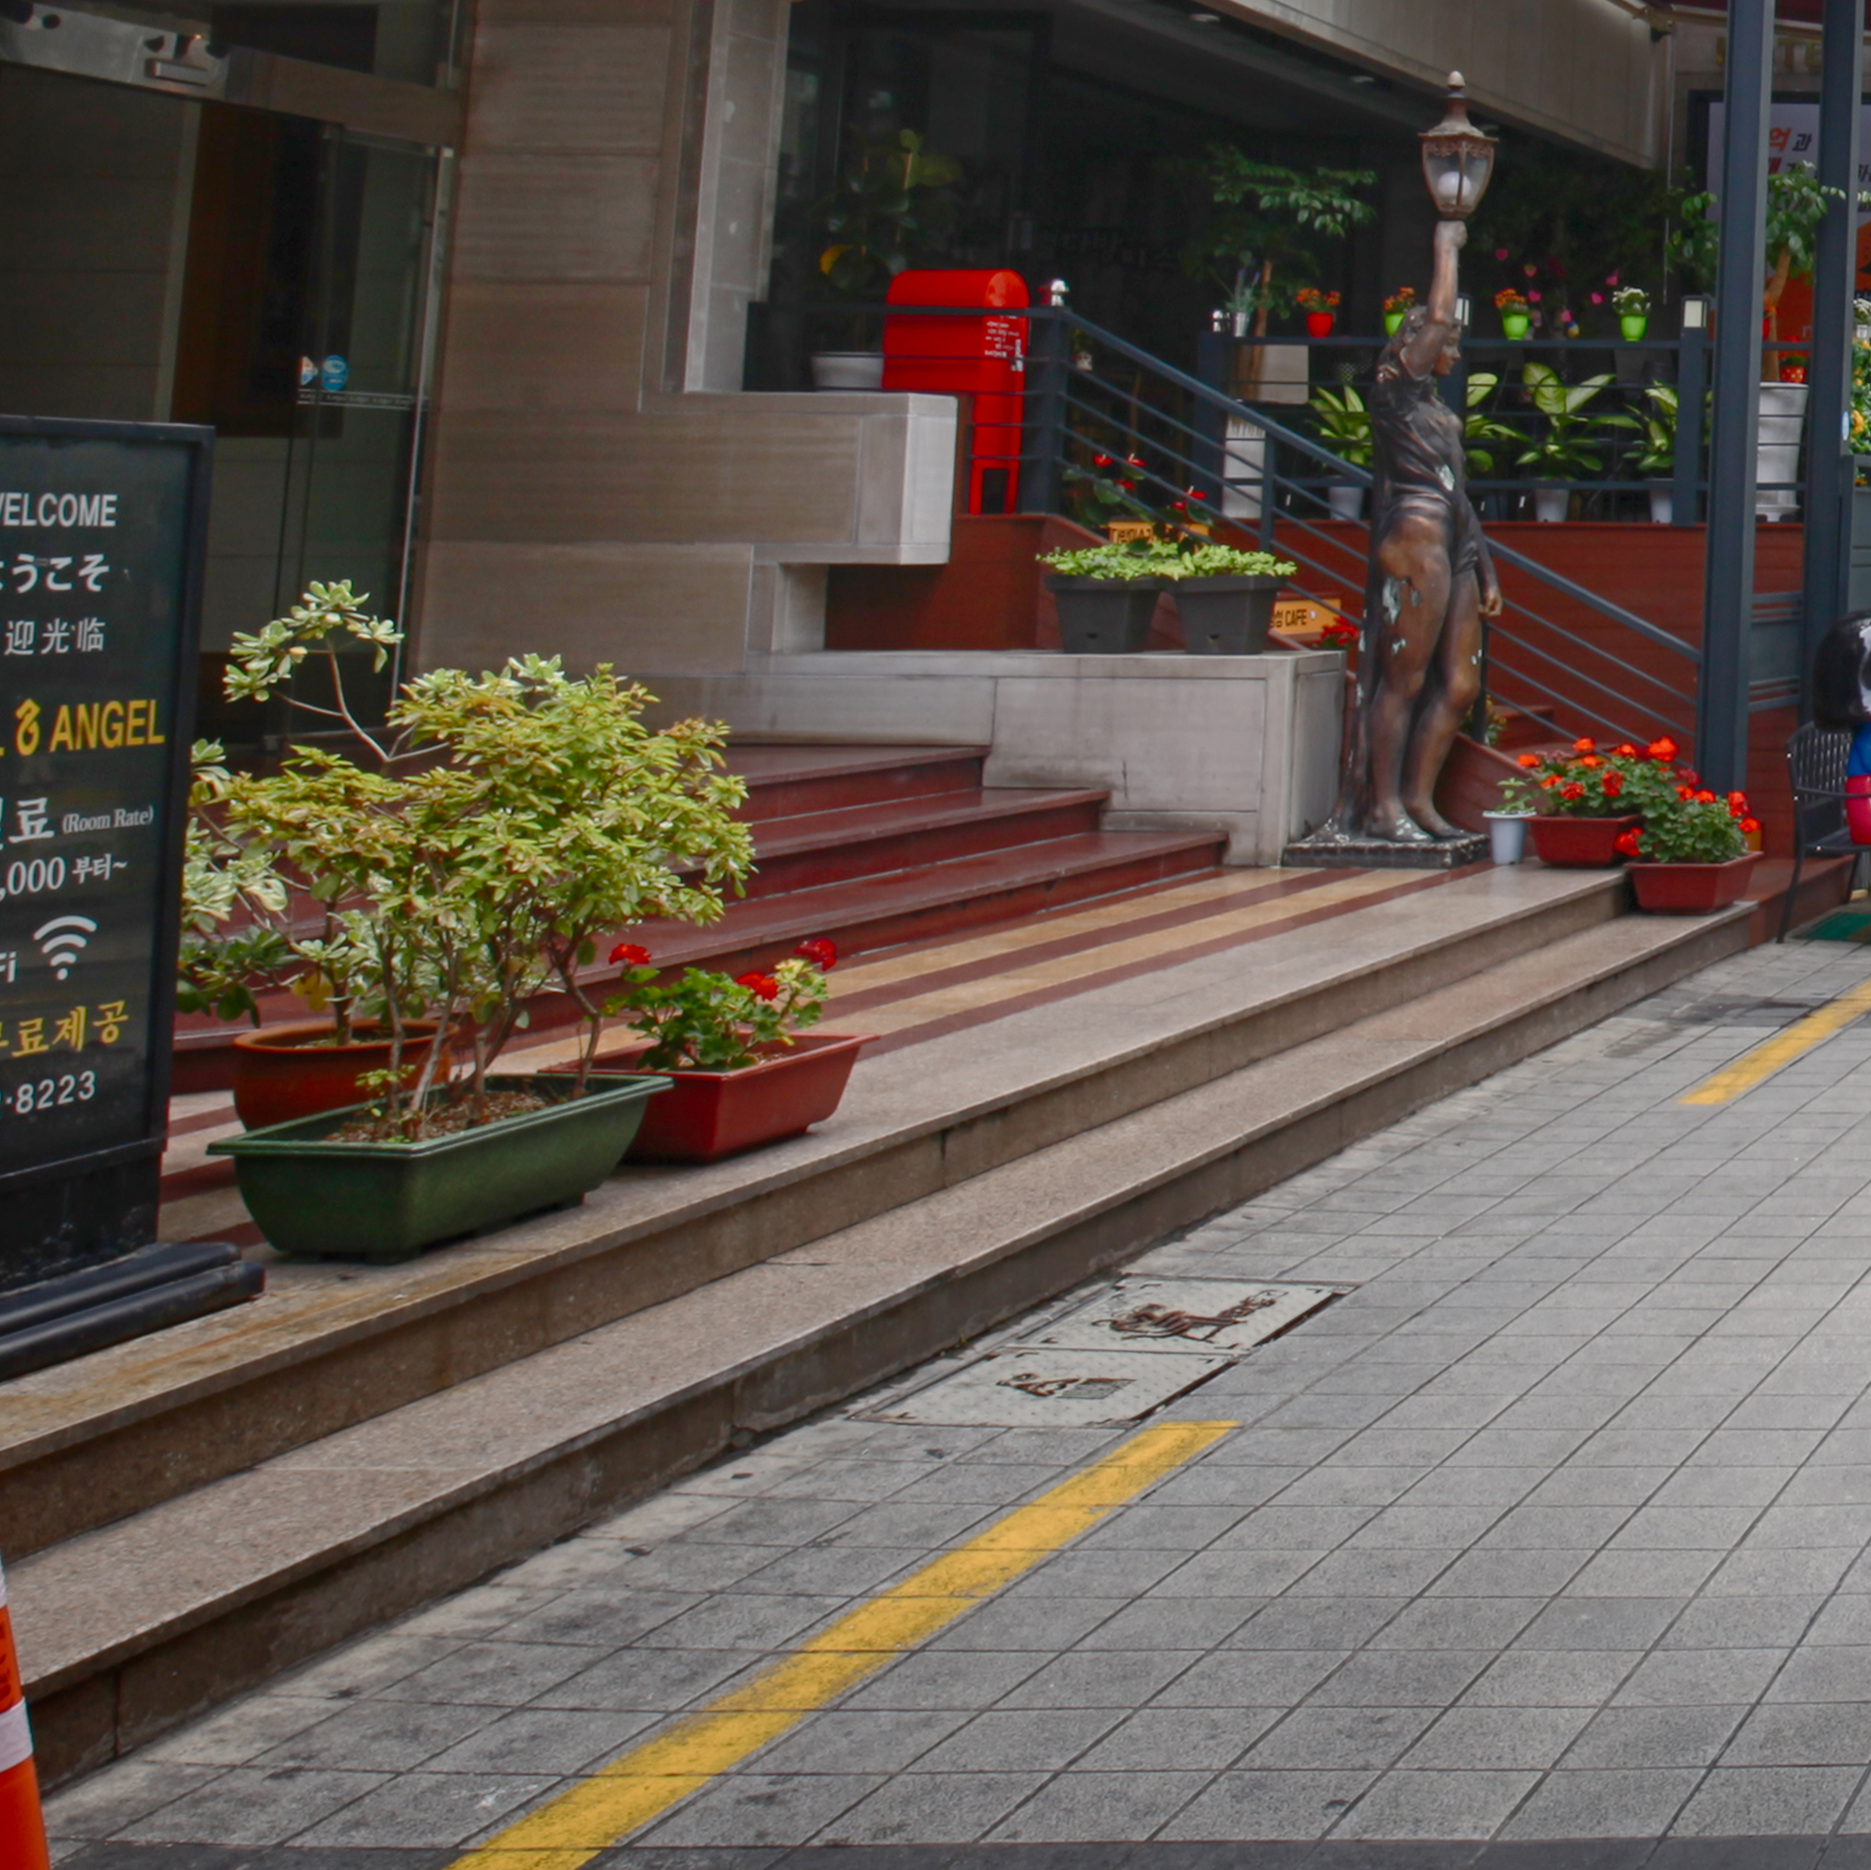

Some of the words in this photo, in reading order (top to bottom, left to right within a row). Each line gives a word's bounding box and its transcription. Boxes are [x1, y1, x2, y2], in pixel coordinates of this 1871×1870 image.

[0, 492, 117, 527] ELCOME
[0, 553, 110, 594] うこそ
[1284, 608, 1307, 627] CAFE
[49, 699, 166, 752] ANGEL
[0, 796, 54, 843] 료
[62, 813, 111, 834] (Room
[113, 804, 154, 828] Rate)
